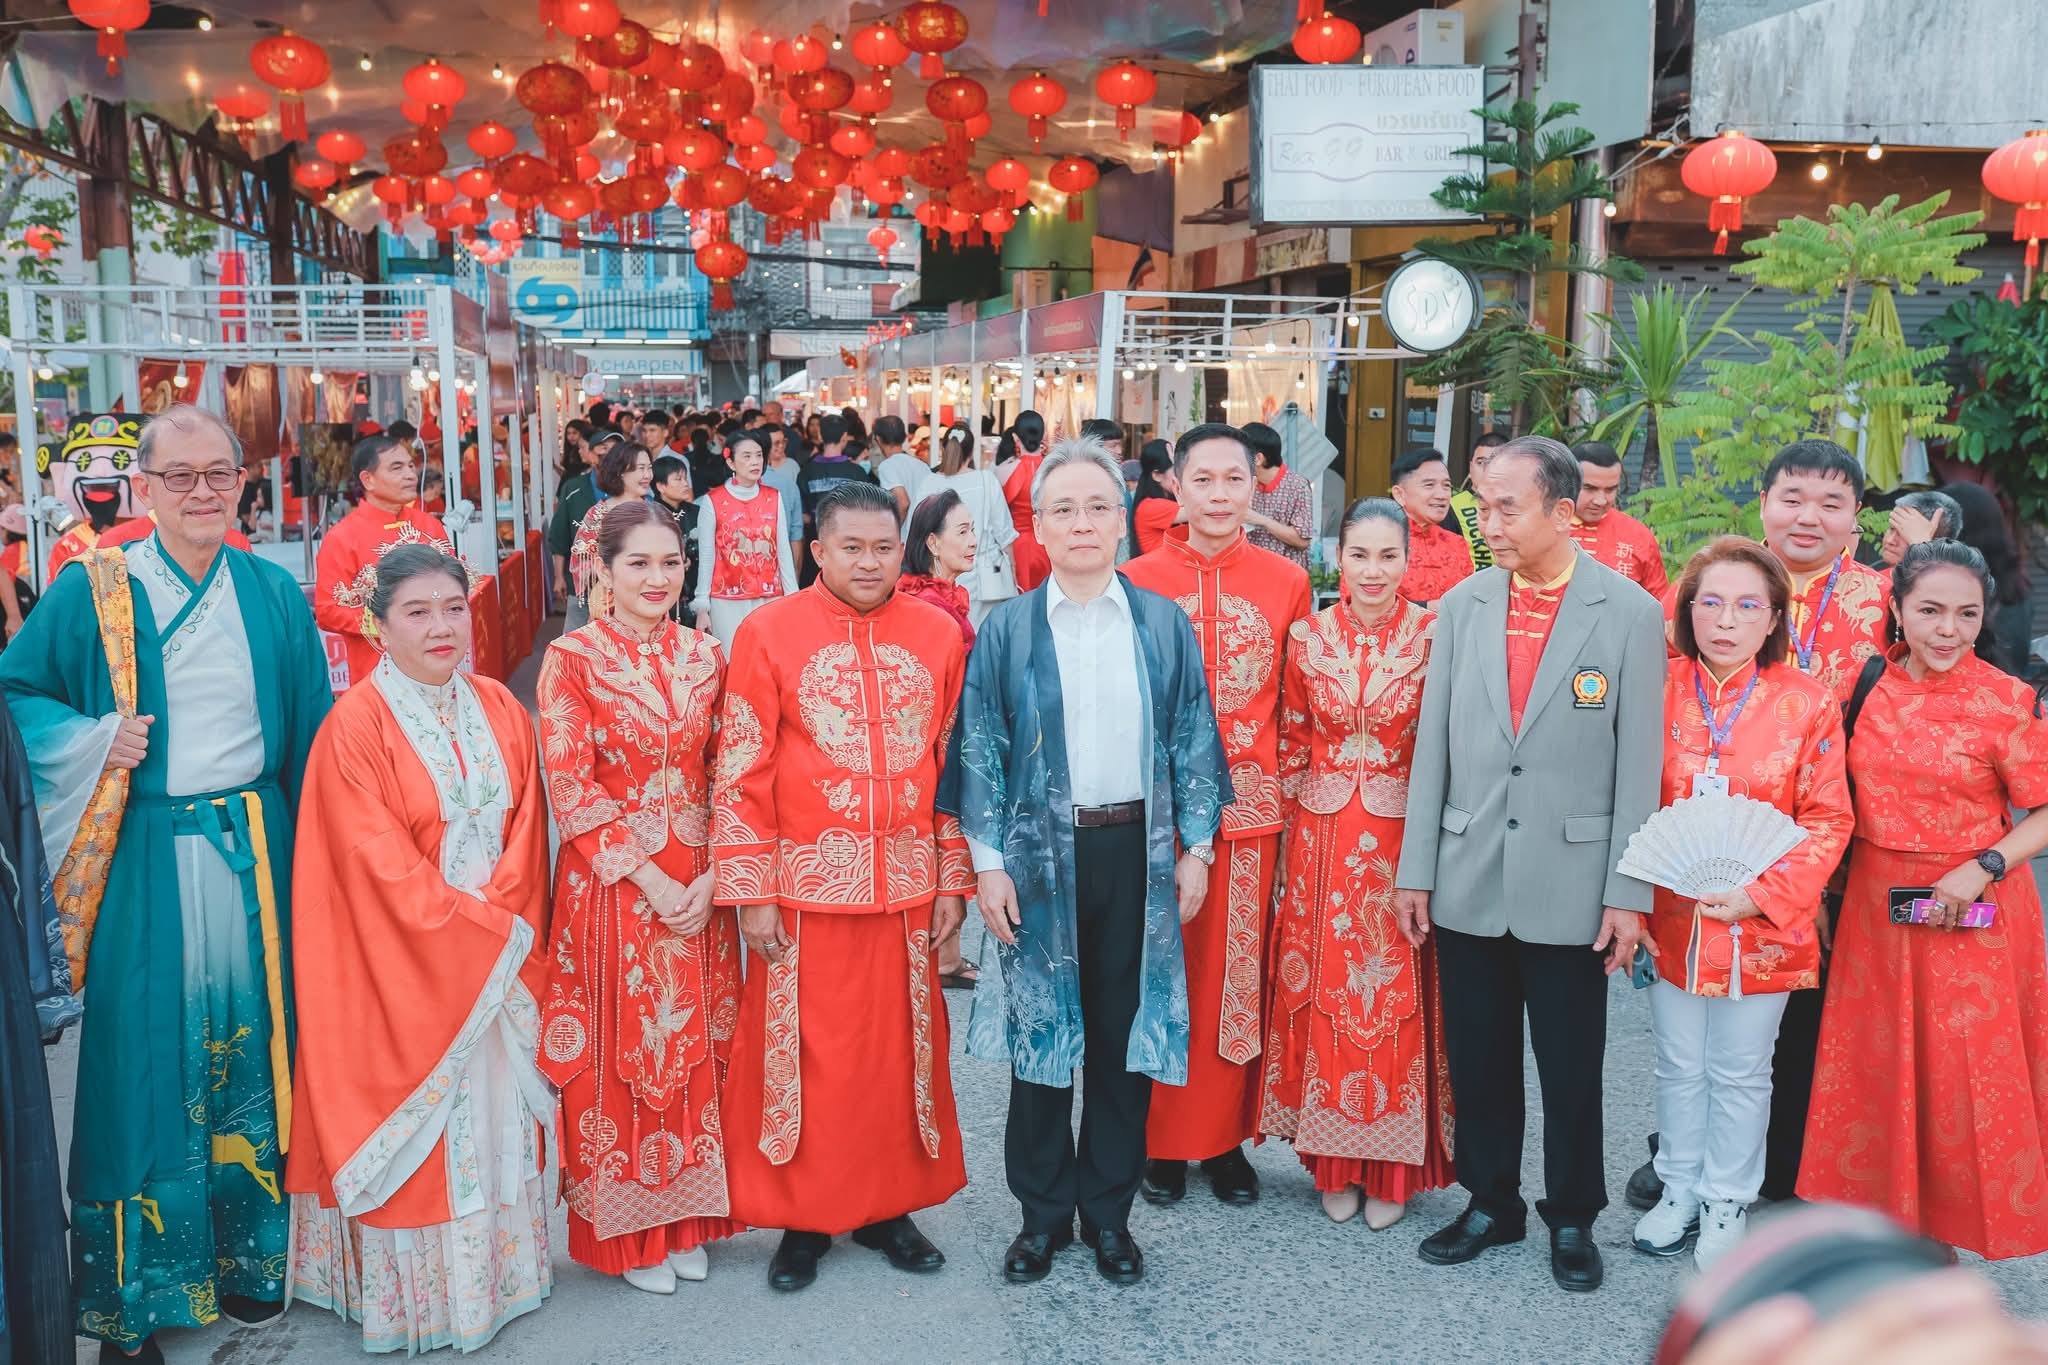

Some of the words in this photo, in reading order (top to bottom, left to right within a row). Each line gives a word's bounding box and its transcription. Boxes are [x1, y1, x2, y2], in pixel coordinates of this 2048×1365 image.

[1267, 71, 1298, 96] THAI
[1304, 71, 1343, 96] FOOD
[1358, 71, 1432, 96] EUROPEAN
[1438, 71, 1476, 96] FOOD
[601, 359, 685, 371] CHAROEN
